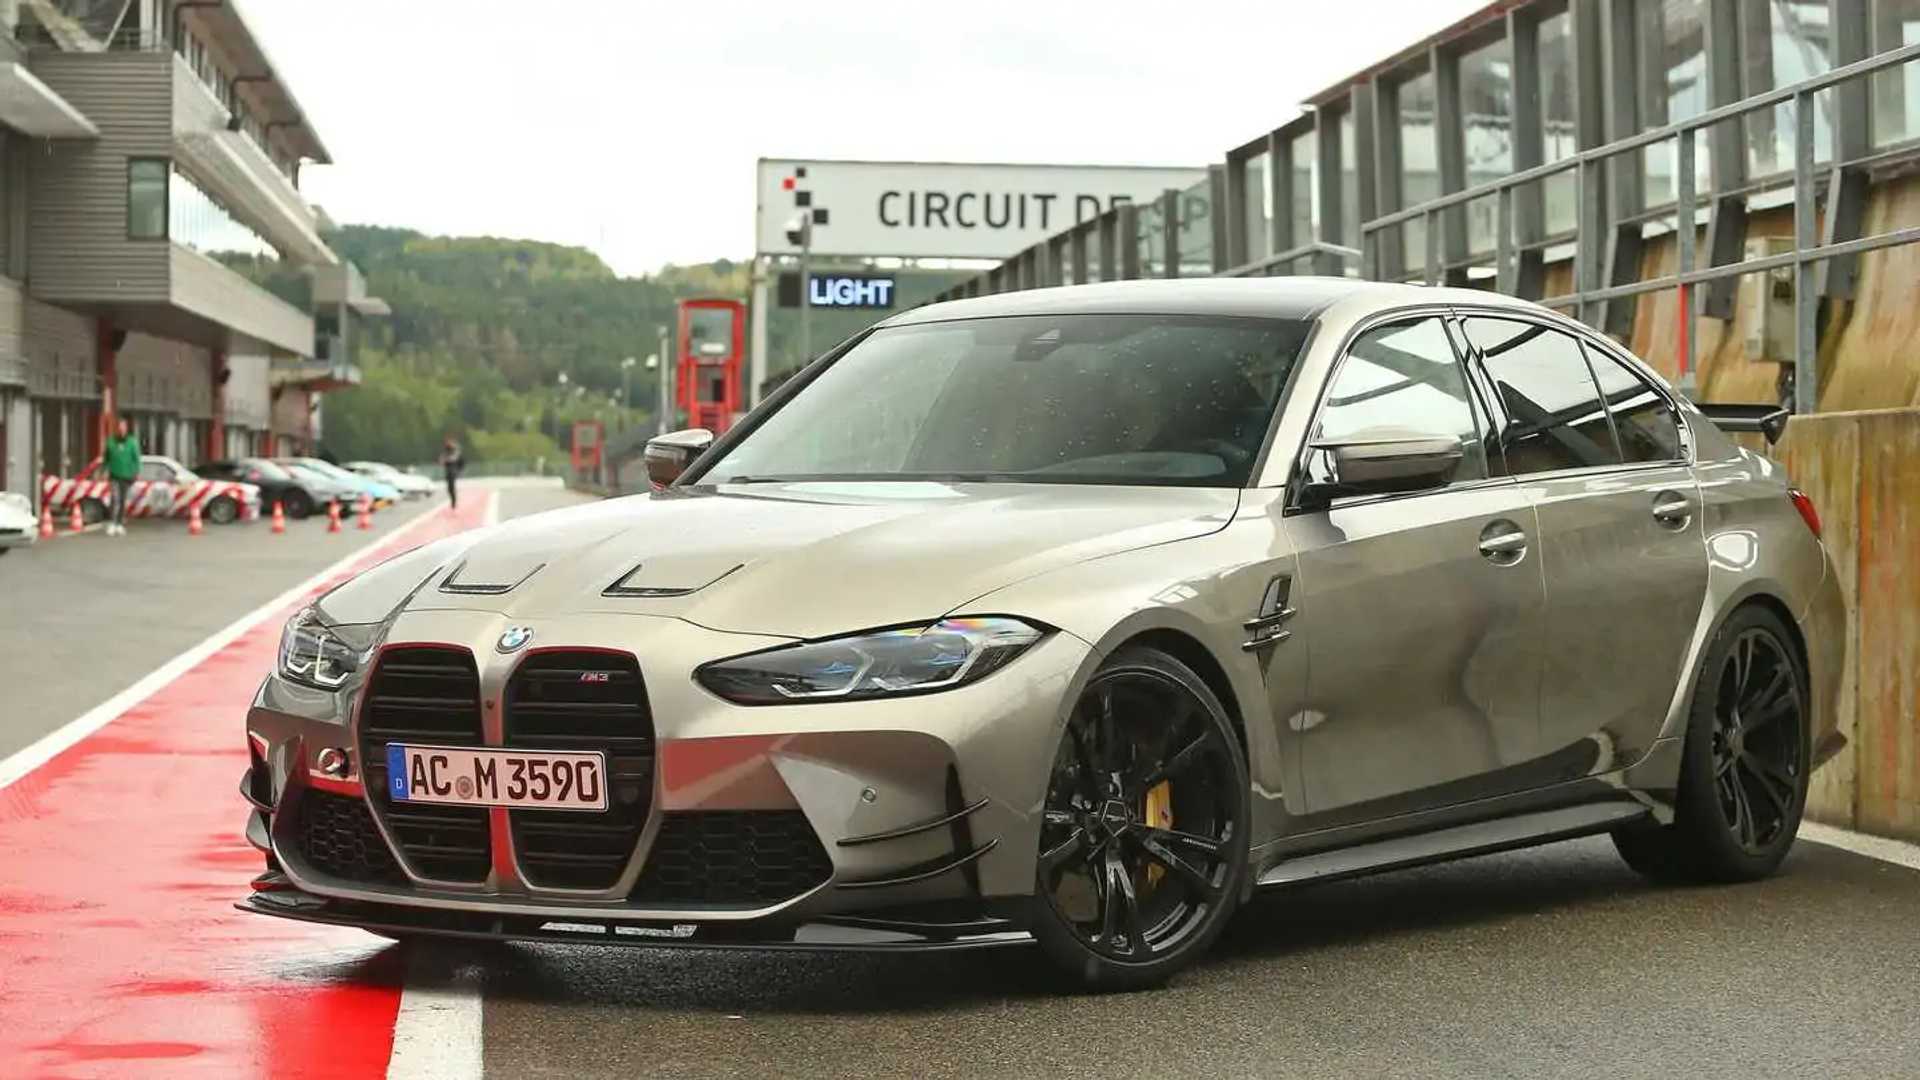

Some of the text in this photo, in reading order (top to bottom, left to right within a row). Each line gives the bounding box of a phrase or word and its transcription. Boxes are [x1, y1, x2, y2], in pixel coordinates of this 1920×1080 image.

[879, 191, 1057, 229] CIRCUIT
[810, 278, 894, 305] LIGHT
[395, 778, 403, 790] D
[411, 754, 599, 802] AC M 3590
